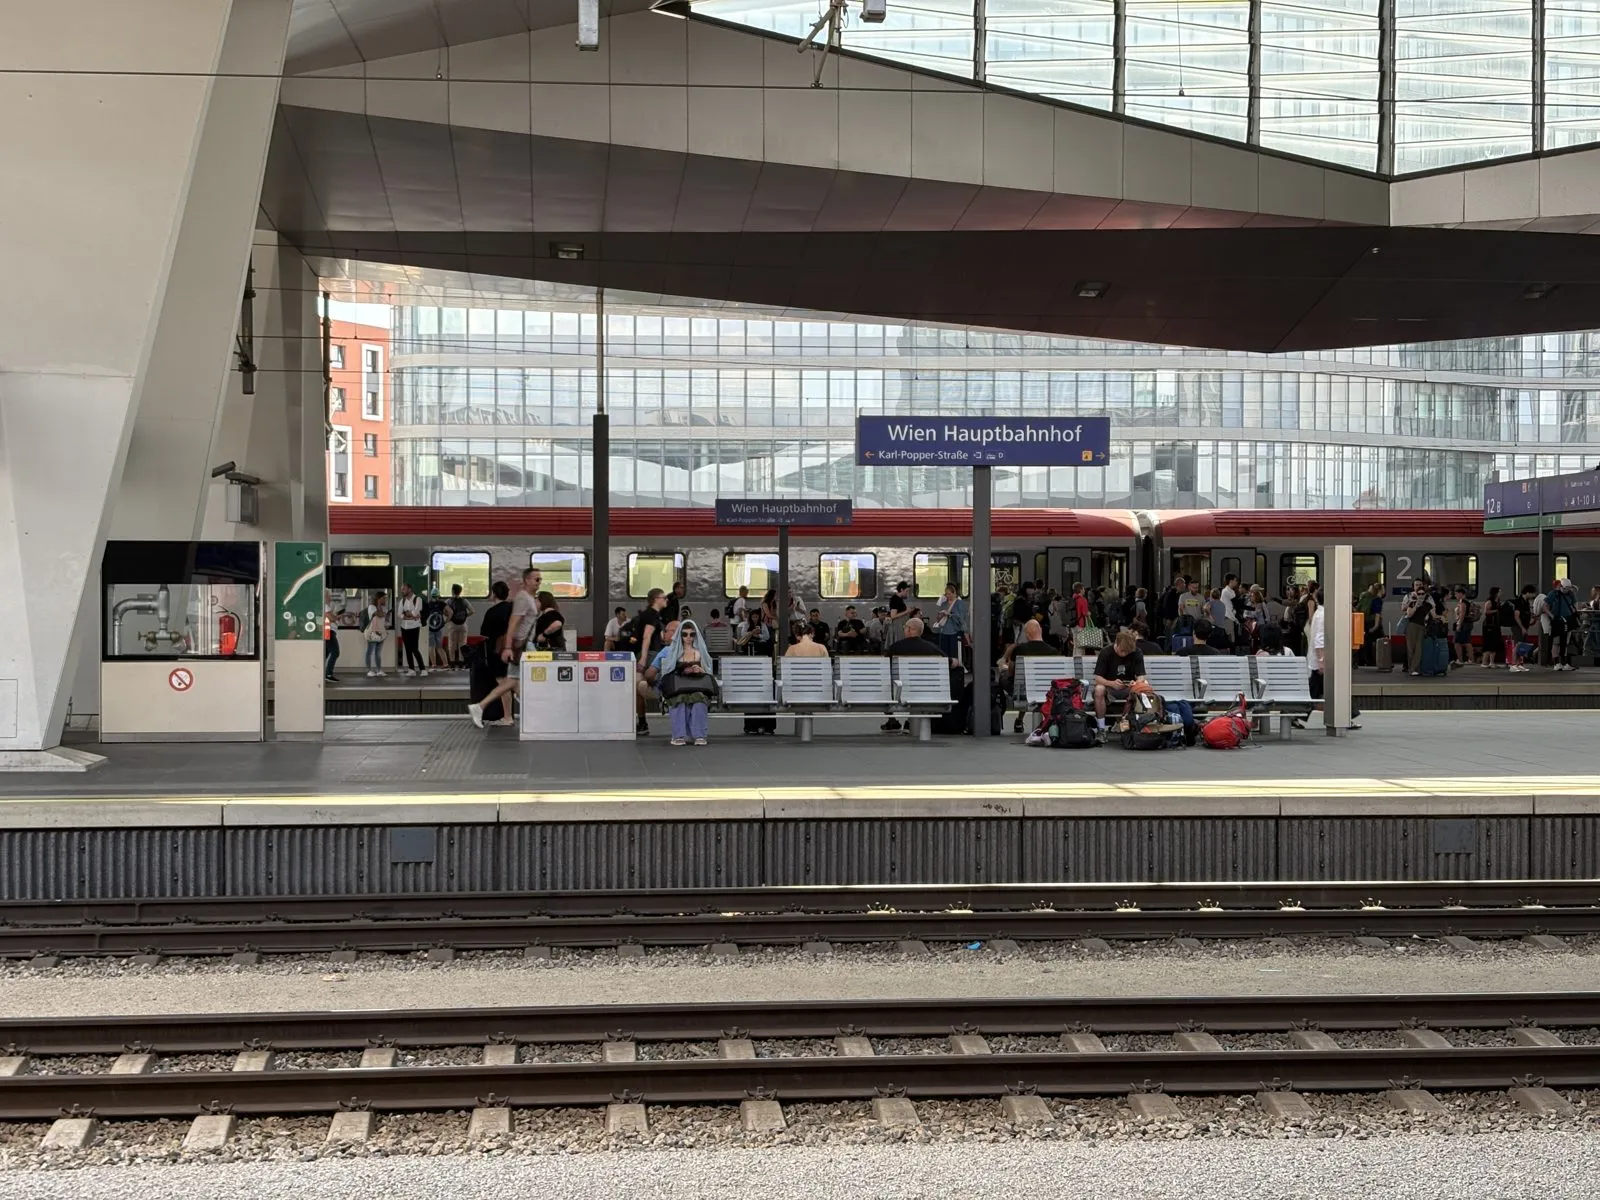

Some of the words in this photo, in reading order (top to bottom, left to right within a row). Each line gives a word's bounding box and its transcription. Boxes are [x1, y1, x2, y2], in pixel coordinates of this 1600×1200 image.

[888, 425, 936, 441] Wien
[944, 424, 1083, 446] Hauptbahnhof
[879, 450, 969, 461] Karl-Popper-Straße
[731, 504, 758, 513] Wien
[762, 503, 837, 515] Hauptbahnhof
[1486, 498, 1495, 514] 12
[1396, 556, 1412, 579] 2
